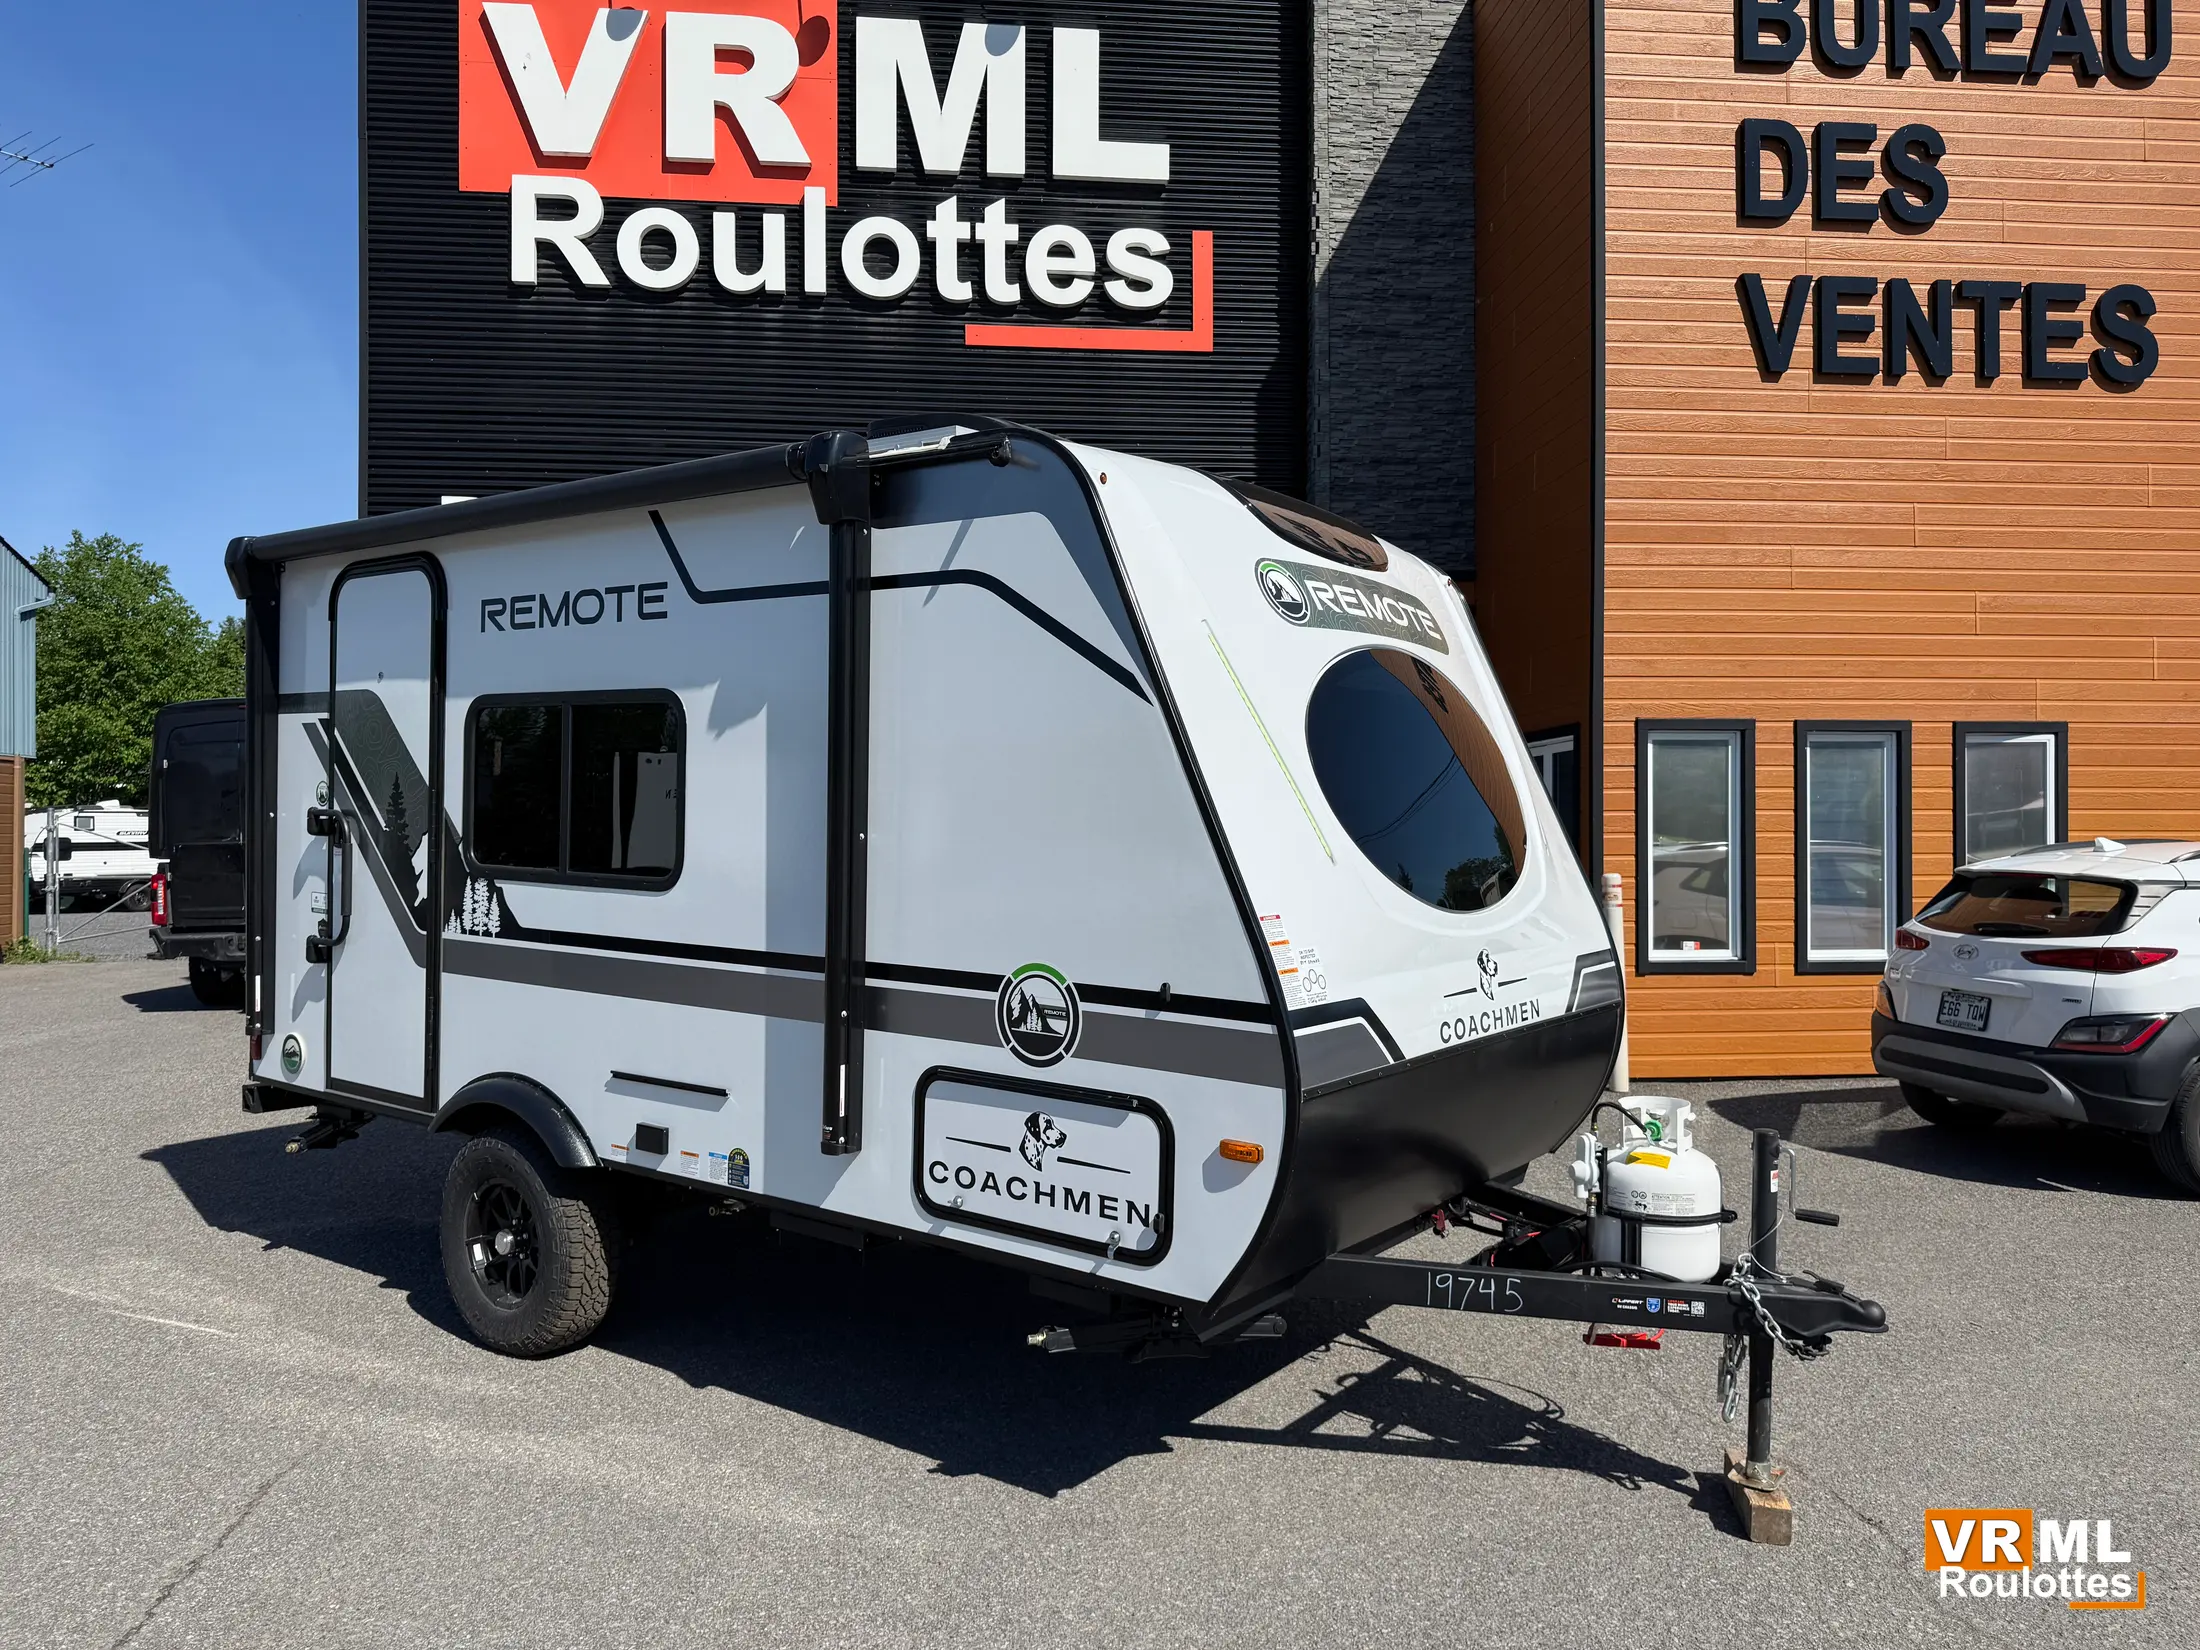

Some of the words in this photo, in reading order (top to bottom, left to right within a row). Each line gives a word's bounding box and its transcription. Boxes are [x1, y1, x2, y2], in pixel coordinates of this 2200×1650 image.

[1736, 0, 2173, 82] BUREAU
[1736, 118, 1949, 227] DES
[510, 174, 1175, 311] Roulottes
[1735, 272, 2160, 385] VENTES
[480, 581, 668, 633] REMOTE
[1303, 579, 1442, 641] REMOTE
[1043, 1009, 1067, 1017] REMOTE
[1440, 999, 1541, 1044] COACHMEN
[1941, 1000, 1961, 1017] E66
[928, 1160, 1151, 1228] COACHMEN
[1426, 1271, 1524, 1313] 19745
